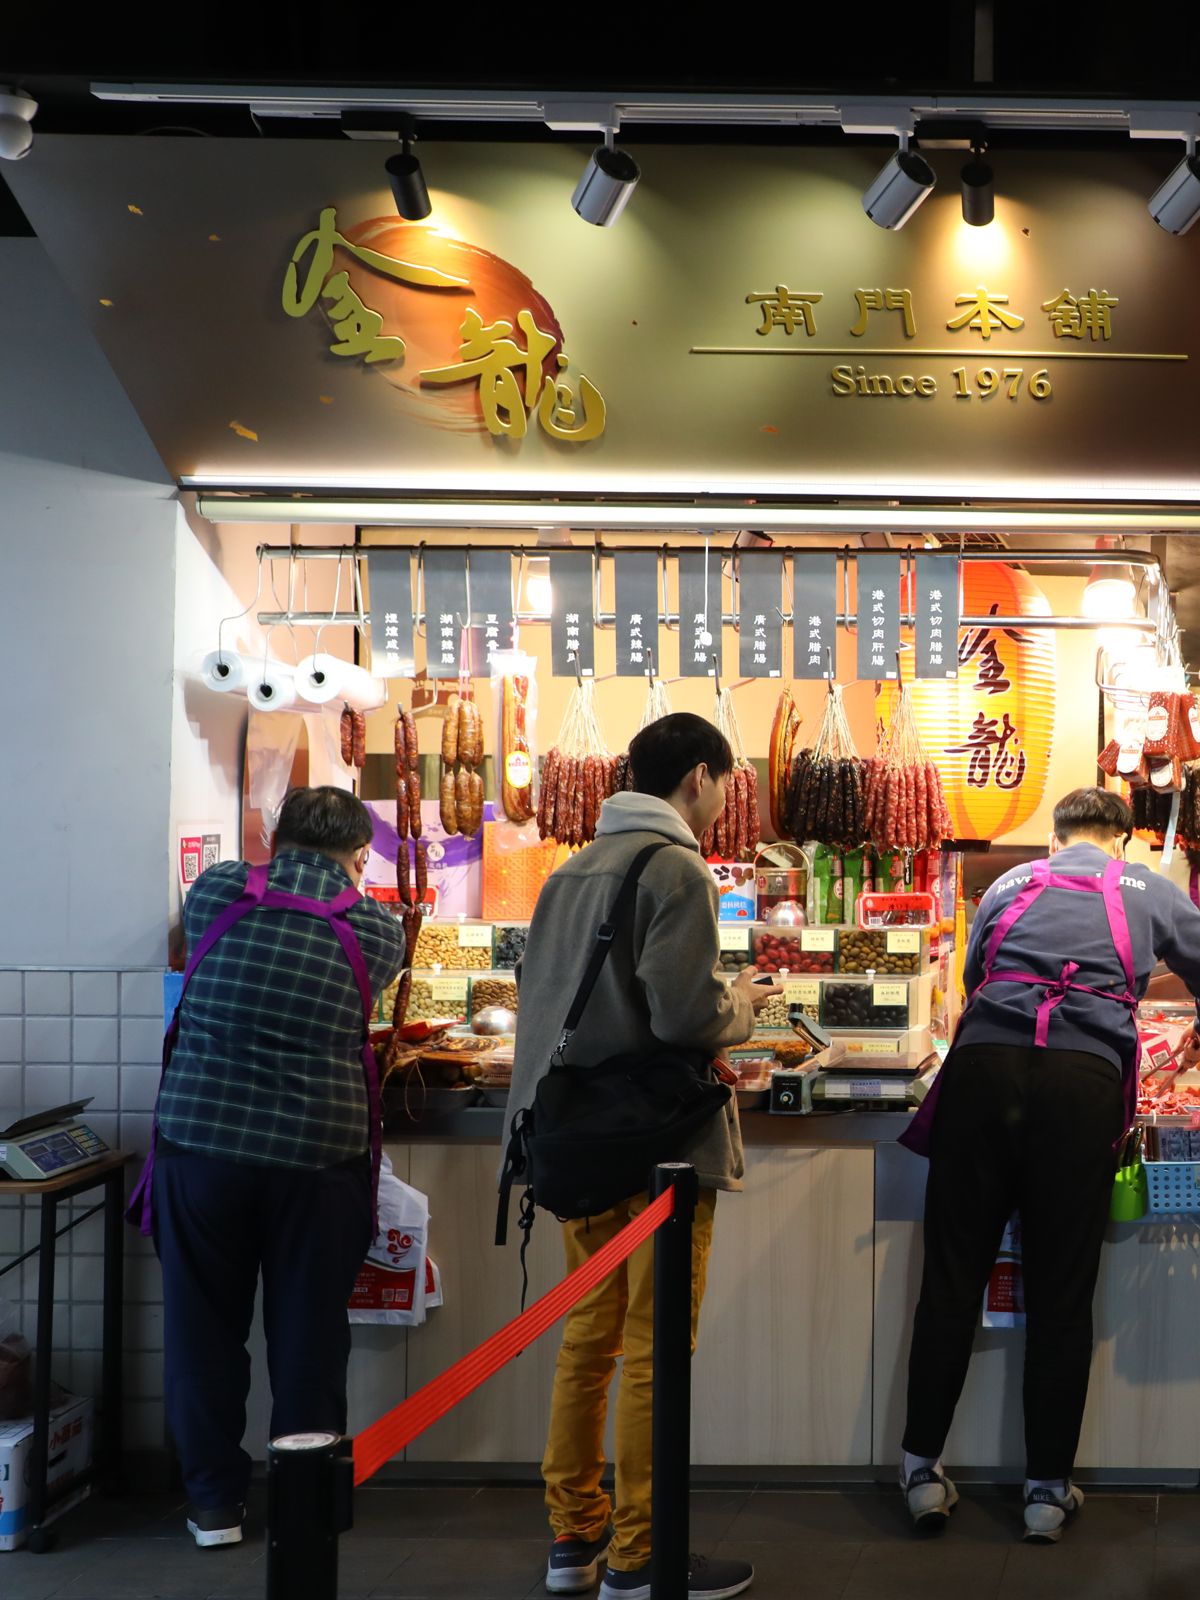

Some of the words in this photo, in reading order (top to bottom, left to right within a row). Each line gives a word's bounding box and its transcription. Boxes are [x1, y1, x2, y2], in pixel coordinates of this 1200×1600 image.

[281, 208, 606, 441] 金龍
[745, 284, 1120, 341] 南門本舖
[832, 364, 937, 397] Since
[953, 366, 1053, 400] 1976
